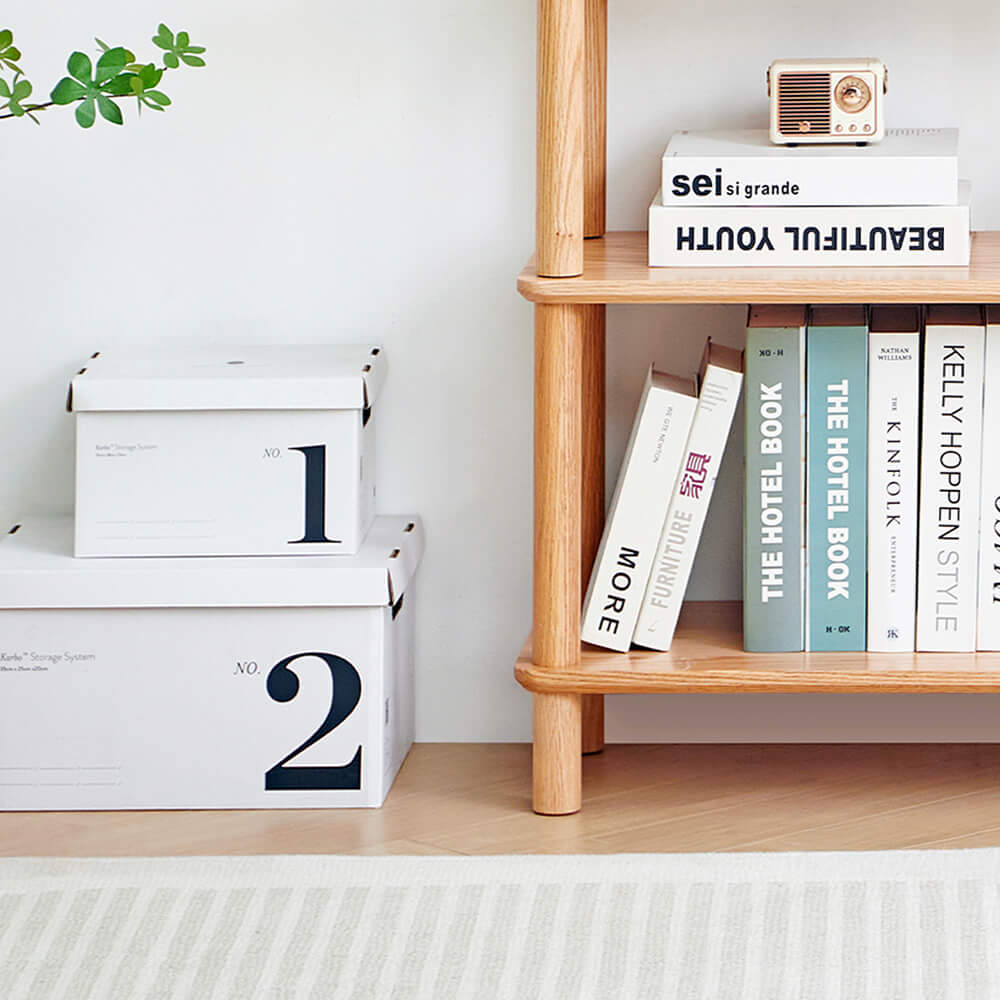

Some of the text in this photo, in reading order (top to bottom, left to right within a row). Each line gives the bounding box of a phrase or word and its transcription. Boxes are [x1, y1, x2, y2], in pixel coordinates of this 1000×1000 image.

[671, 167, 800, 200] sei si grande
[676, 226, 945, 252] BEAUTIFUL YOUTH
[262, 447, 283, 458] NO.
[287, 444, 342, 544] 1
[759, 380, 784, 604] THE HOTEL BOOK
[825, 379, 850, 601] THE HOTEL BOOK
[886, 421, 901, 527] KINFOLK
[935, 345, 966, 632] KELLY HOPPEN STYLE
[597, 546, 640, 635] MORE
[650, 509, 693, 609] FURNITURE
[30, 652, 62, 664] Storage
[64, 652, 96, 663] System
[233, 651, 363, 791] NO. 2
